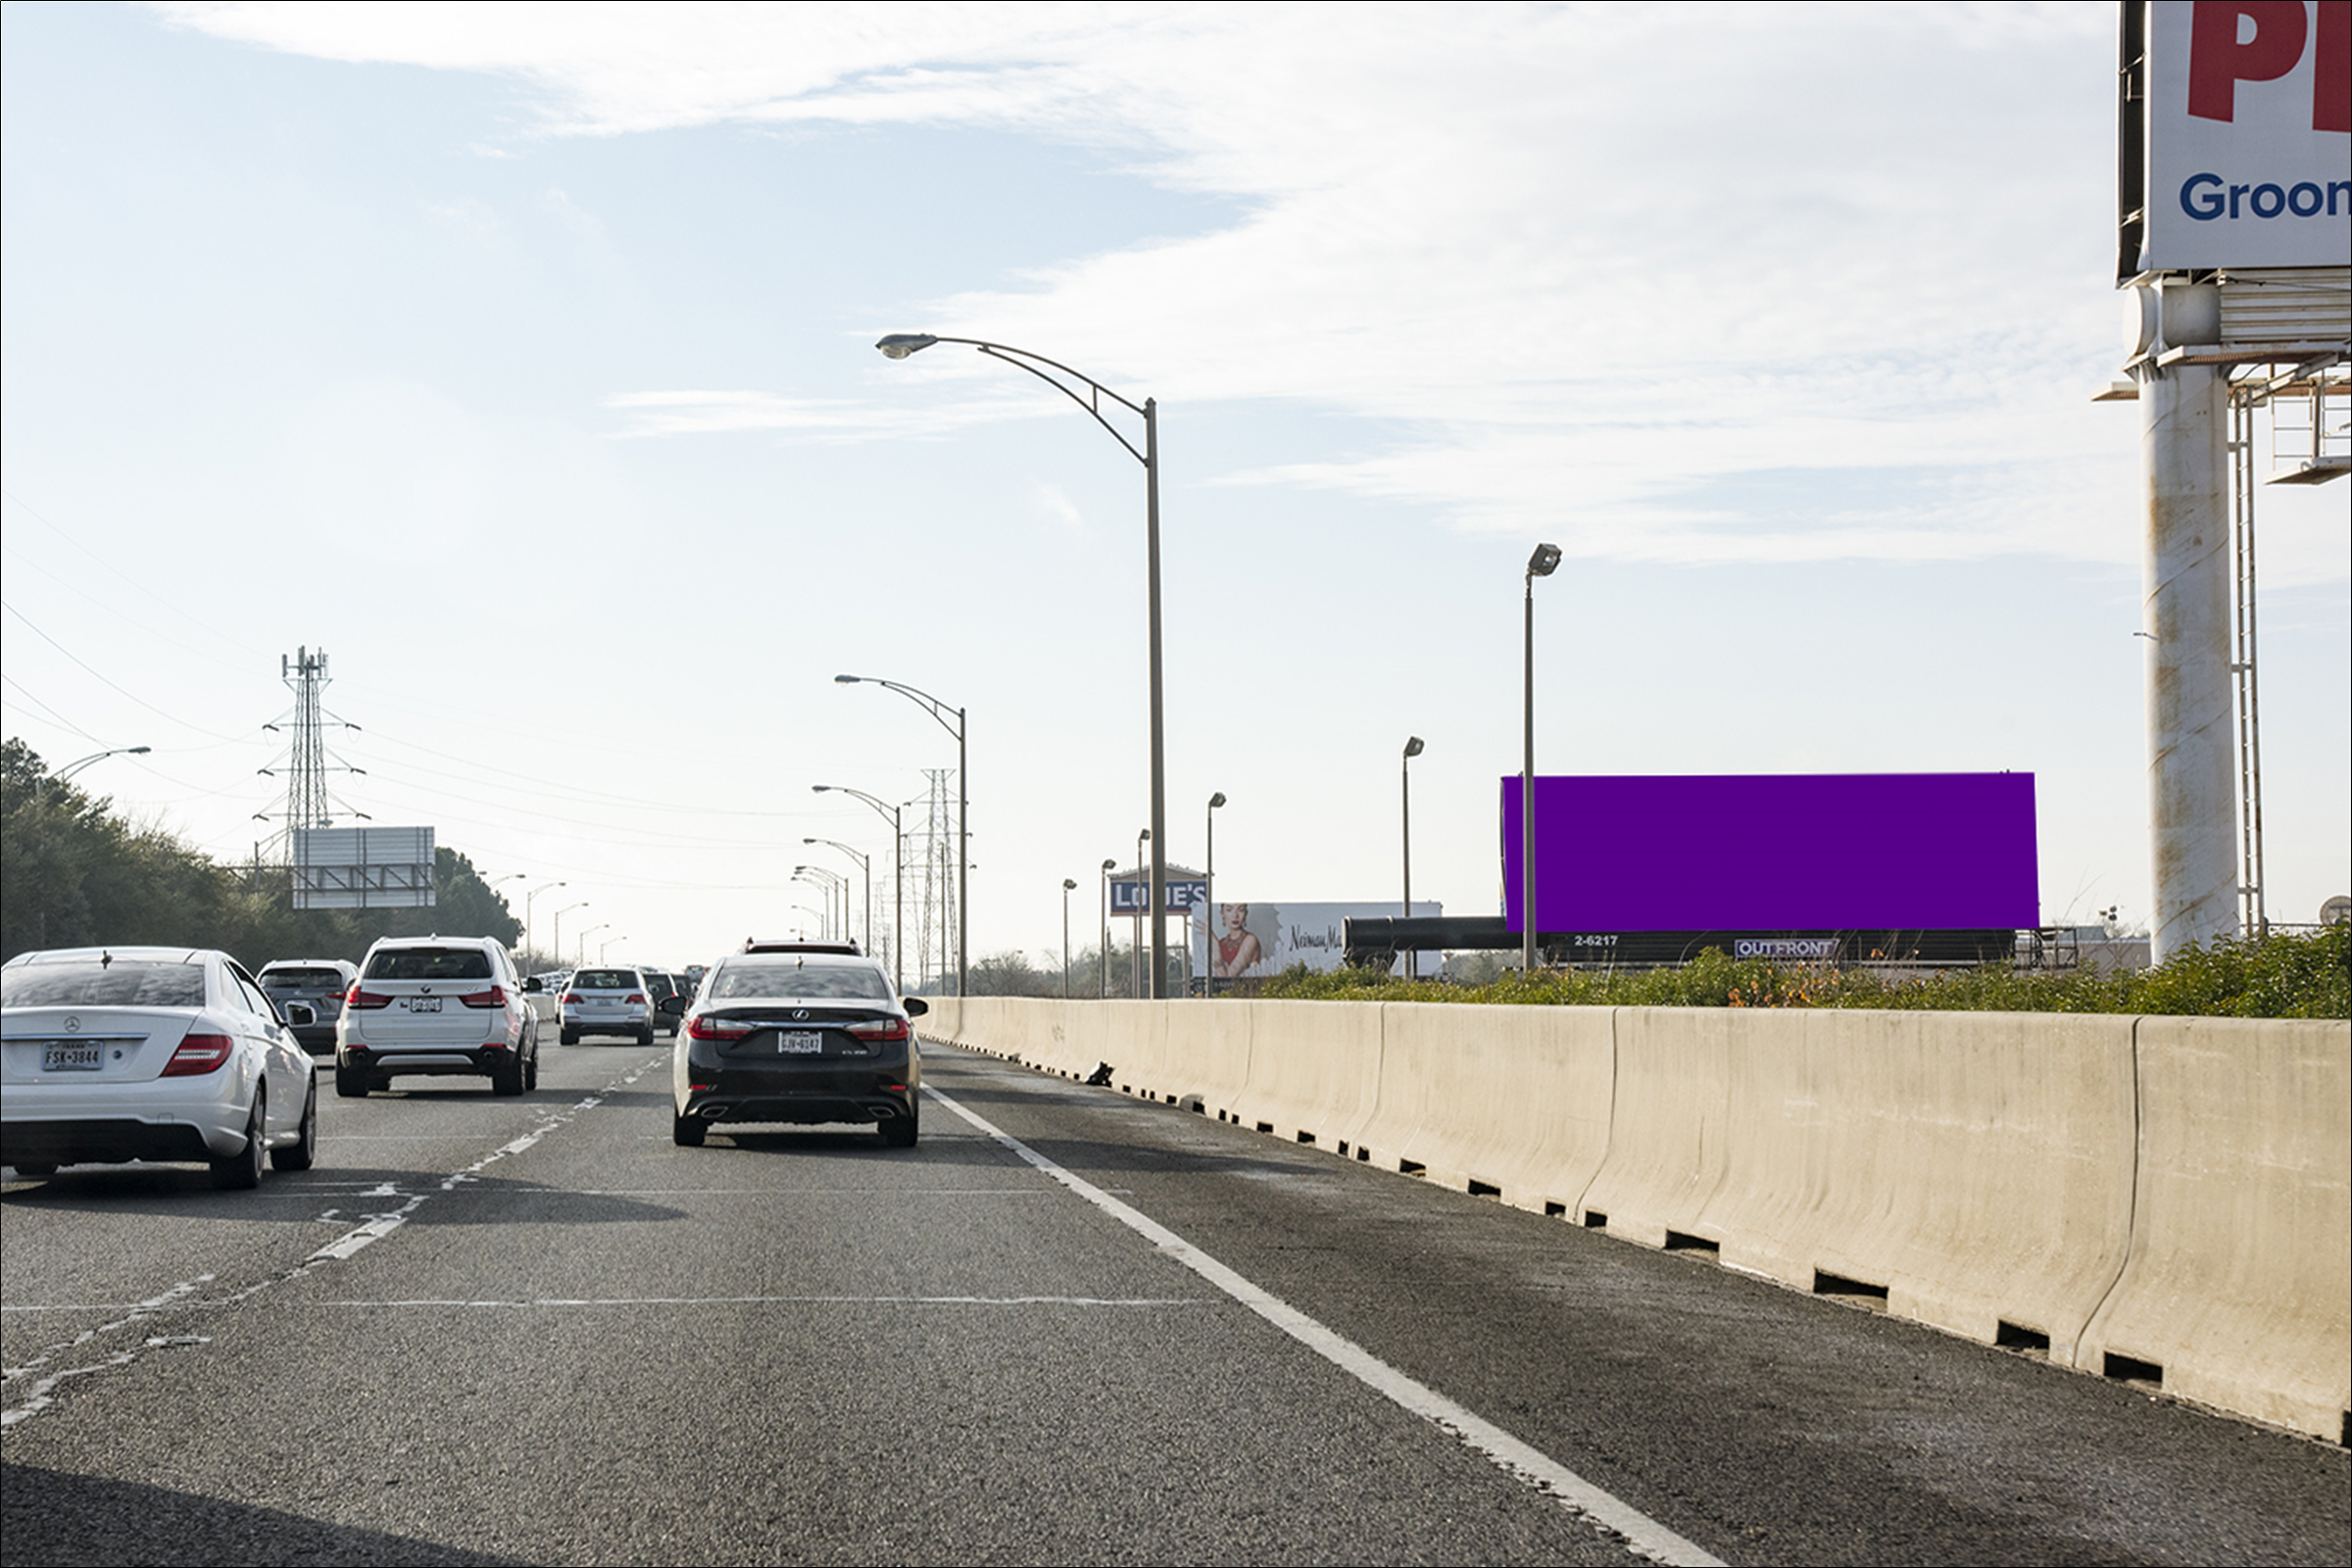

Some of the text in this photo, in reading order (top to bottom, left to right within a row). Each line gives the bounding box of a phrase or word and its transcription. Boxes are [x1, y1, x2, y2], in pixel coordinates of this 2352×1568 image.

[2187, 1, 2351, 132] P
[1115, 884, 1206, 906] LOE'S
[1574, 935, 1618, 947] 2-6217
[1739, 941, 1833, 956] OUTFRONT
